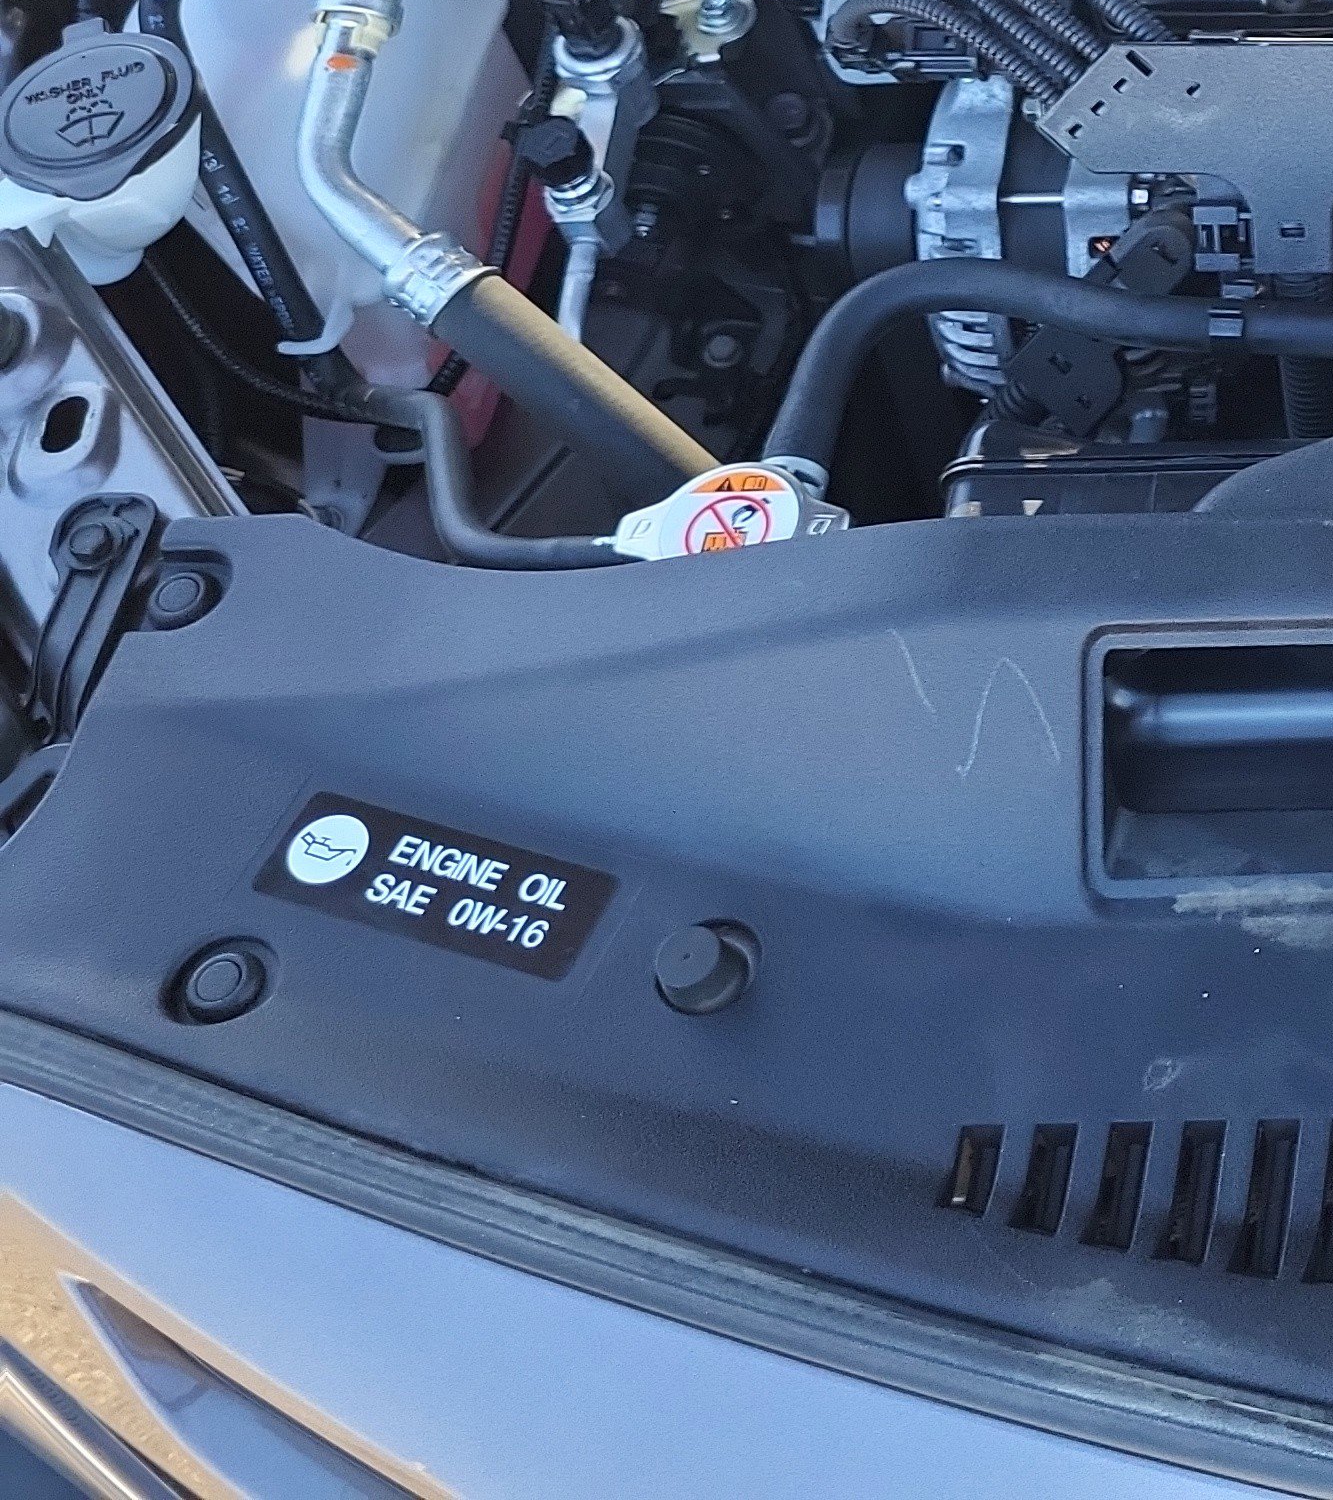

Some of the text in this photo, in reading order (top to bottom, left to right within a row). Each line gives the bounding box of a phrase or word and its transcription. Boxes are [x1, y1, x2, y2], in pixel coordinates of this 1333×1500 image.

[66, 83, 107, 105] ONLY
[100, 61, 146, 82] FLUID
[388, 835, 567, 911] ENGINE OIL
[365, 873, 550, 949] SAE 0W-16
